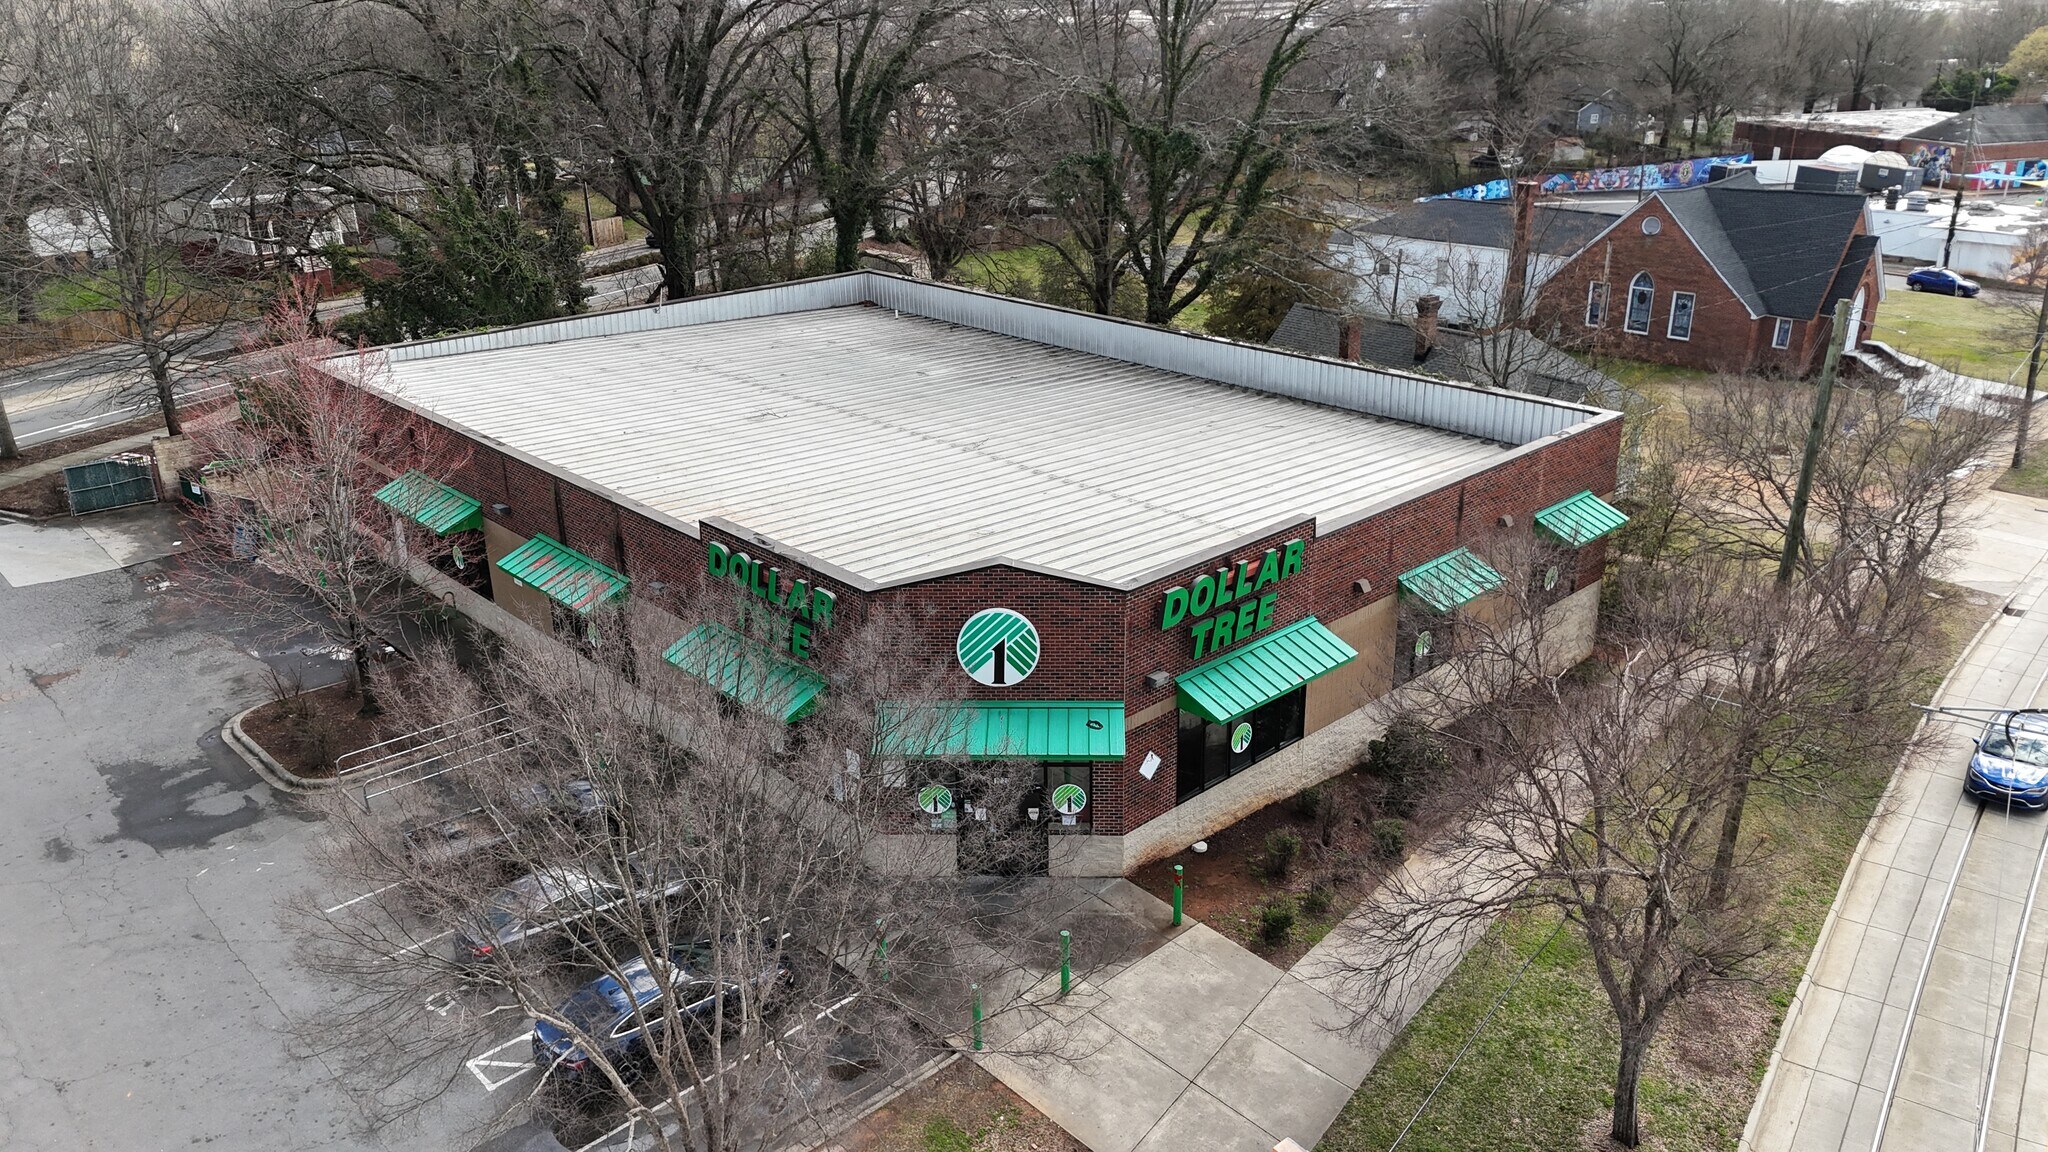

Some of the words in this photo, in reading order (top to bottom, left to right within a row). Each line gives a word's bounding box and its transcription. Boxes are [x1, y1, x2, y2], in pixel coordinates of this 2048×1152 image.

[708, 541, 836, 628] DOLLAR
[1160, 539, 1305, 630] DOLLAR
[991, 638, 1007, 684] 1
[1188, 591, 1277, 660] TREE
